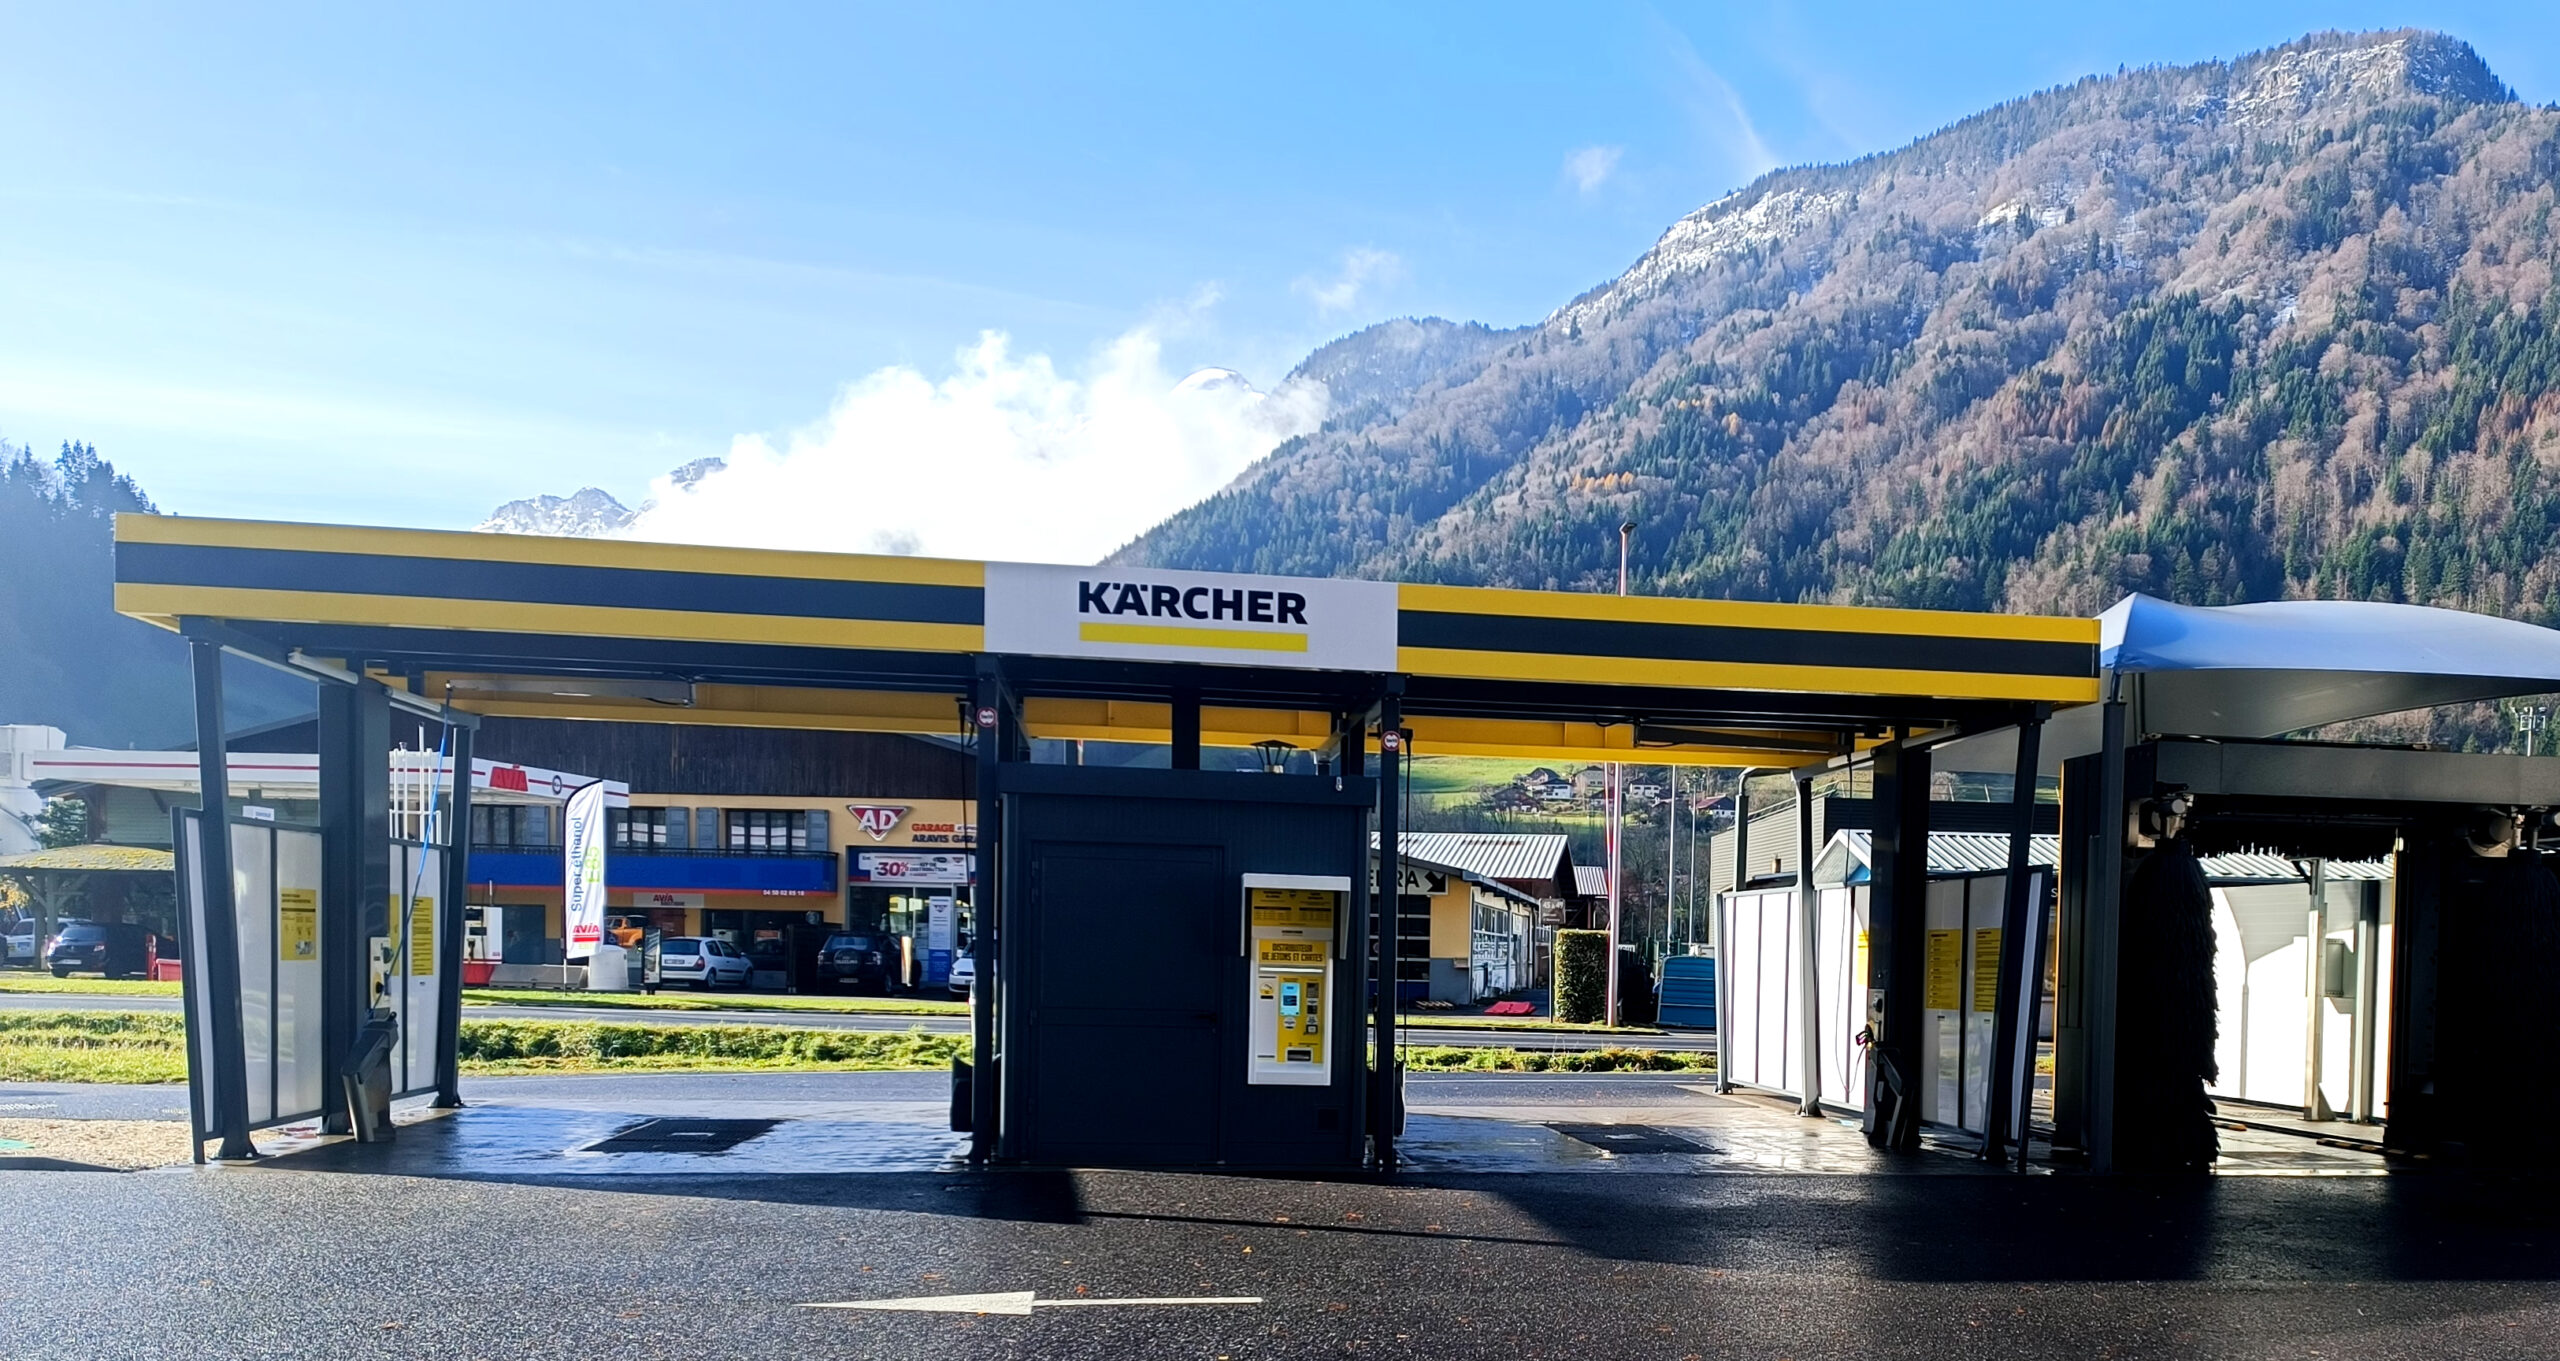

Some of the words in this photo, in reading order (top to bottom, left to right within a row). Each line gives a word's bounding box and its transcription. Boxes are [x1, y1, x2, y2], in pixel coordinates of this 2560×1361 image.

[1078, 580, 1308, 625] KÄRCHER
[489, 763, 529, 792] AVIA
[858, 809, 899, 831] AD
[911, 823, 955, 833] GARAGE
[571, 817, 582, 870] éthanol
[911, 834, 950, 844] ARAVIS
[571, 872, 585, 912] Super
[653, 892, 674, 902] AVIA
[572, 922, 600, 934] AVIA
